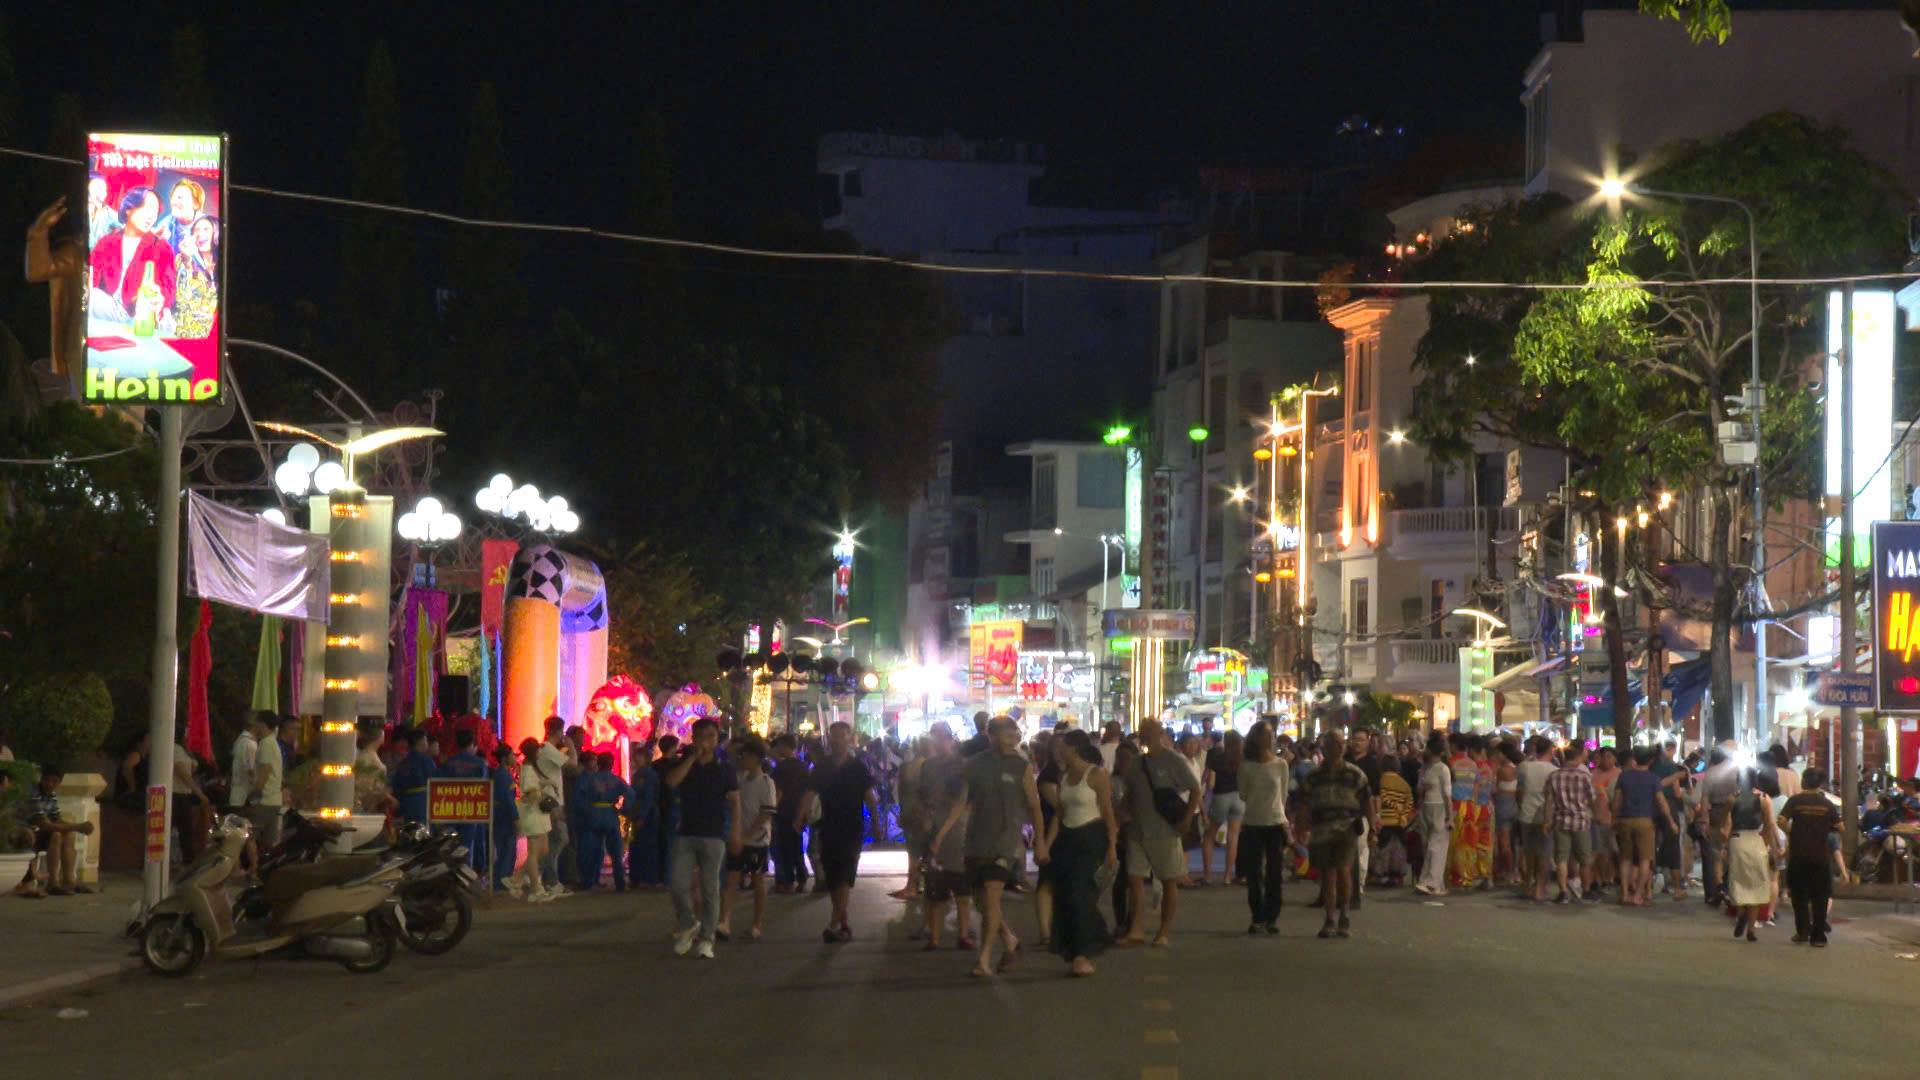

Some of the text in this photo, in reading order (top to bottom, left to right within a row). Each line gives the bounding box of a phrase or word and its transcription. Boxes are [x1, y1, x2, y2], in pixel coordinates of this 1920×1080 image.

[152, 155, 218, 169] Heineken
[1887, 549, 1920, 577] MA
[436, 784, 485, 797] KHU VỰC
[432, 797, 454, 816] CẤM
[476, 801, 489, 816] XE
